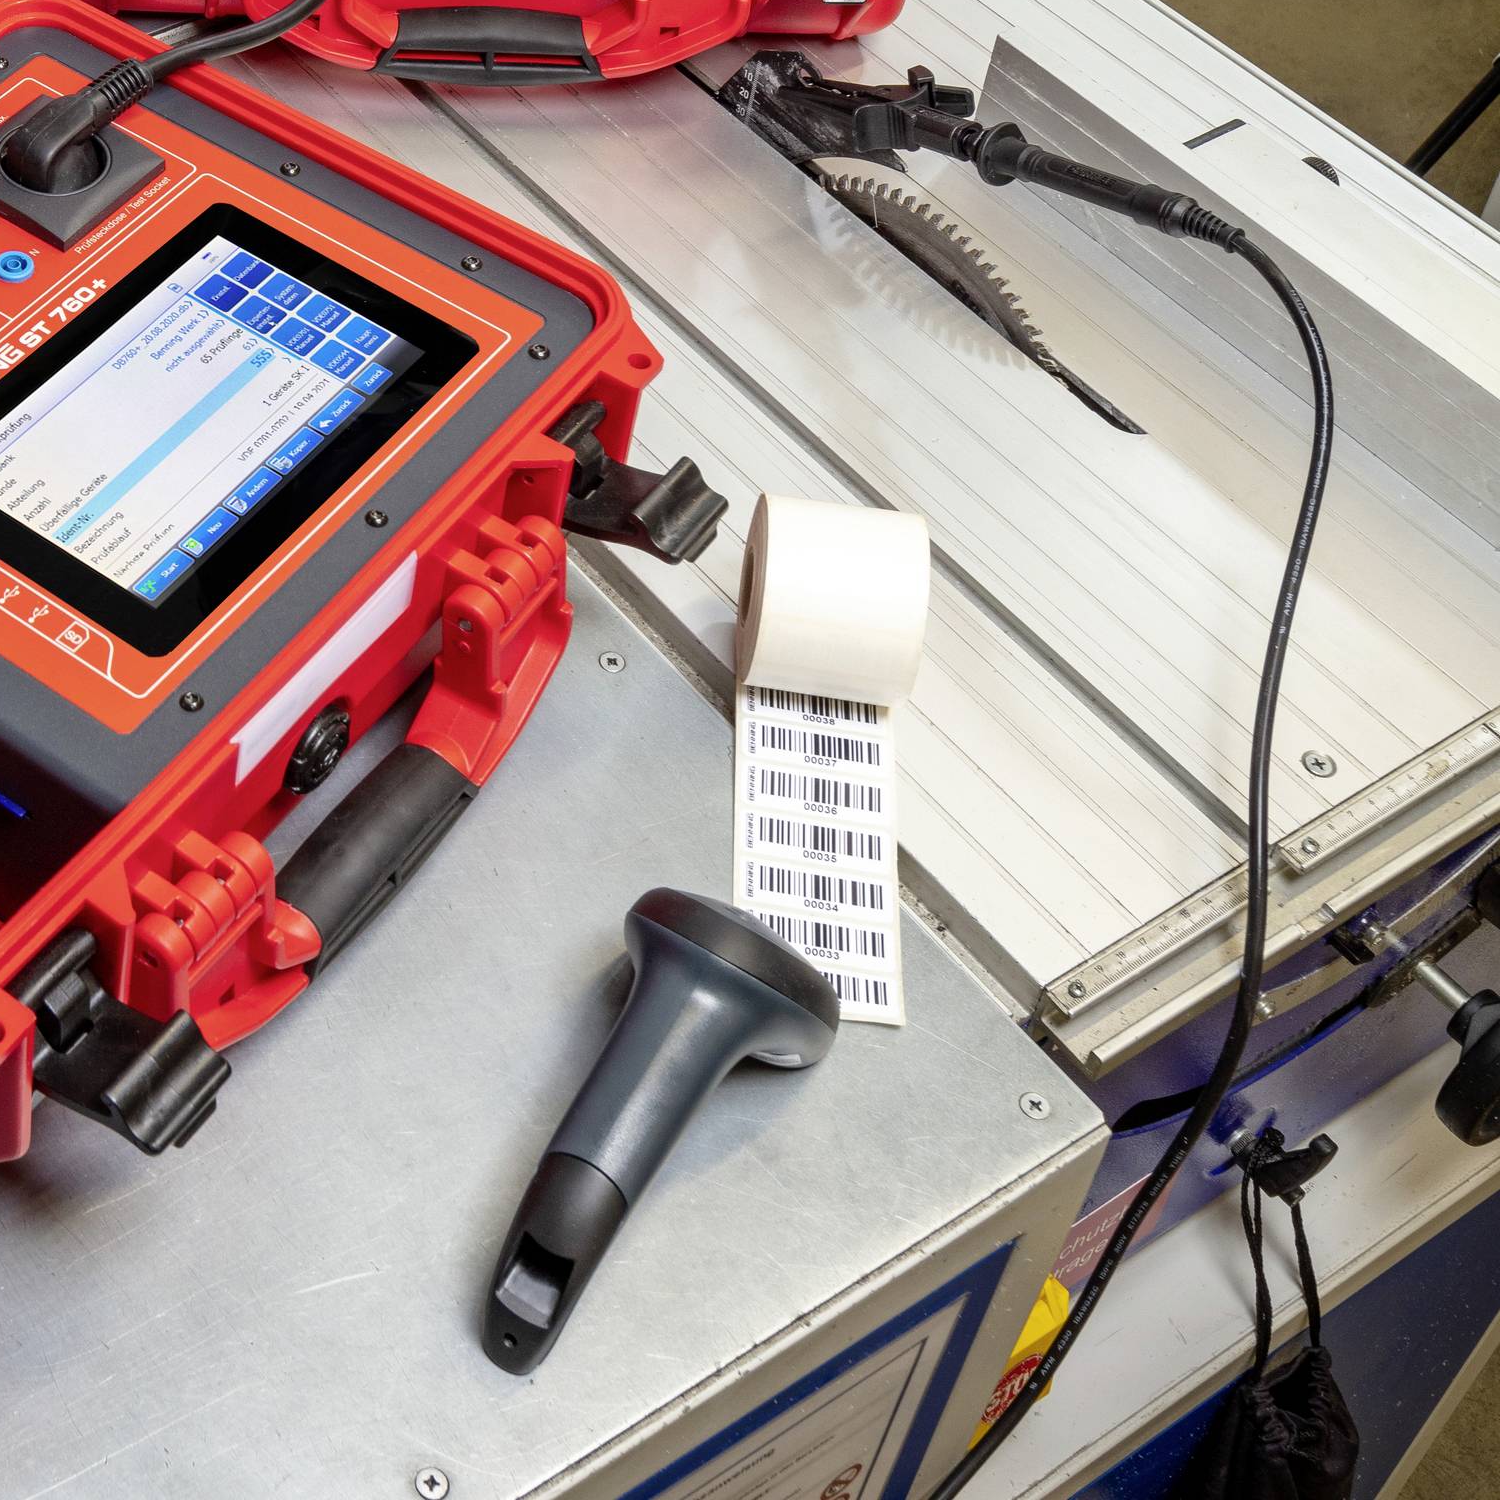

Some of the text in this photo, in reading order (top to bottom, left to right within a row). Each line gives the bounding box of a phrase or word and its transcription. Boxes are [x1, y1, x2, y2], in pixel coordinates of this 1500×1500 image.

[744, 70, 753, 81] 10
[739, 86, 749, 98] 20
[736, 104, 745, 116] 30
[74, 176, 171, 255] Prüfsteckdose Test Socket
[235, 259, 260, 282] Datenbank
[274, 284, 296, 301] System-
[283, 292, 299, 306] daten
[19, 321, 51, 349] ST
[48, 278, 108, 322] 760+
[150, 316, 200, 361] Benning Werk
[166, 322, 221, 373] nicht ausgewählt
[200, 328, 243, 364] 65 Prüflinge
[242, 340, 253, 351] 61
[251, 349, 272, 368] 555
[269, 370, 305, 401] Geräte SK
[364, 369, 385, 387] Zurück
[332, 399, 352, 418] Zurück
[7, 478, 46, 510] Abteilung
[246, 477, 269, 498] Ändern
[24, 497, 51, 522] Anzahl
[39, 473, 108, 532] Überfällige Geräte
[56, 512, 94, 543] Ident-Nr.
[74, 511, 124, 554] Bezeichnung
[207, 521, 223, 534] Neu
[91, 528, 132, 565] Prüfablauf
[160, 562, 179, 578] Start
[64, 629, 82, 645] SD
[802, 714, 835, 726] 00038
[804, 755, 837, 767] 00037
[804, 803, 838, 815] 00036
[803, 850, 837, 862] 00035
[804, 900, 838, 912] 00034
[805, 948, 840, 960] 00033
[1059, 1205, 1128, 1259] chutz
